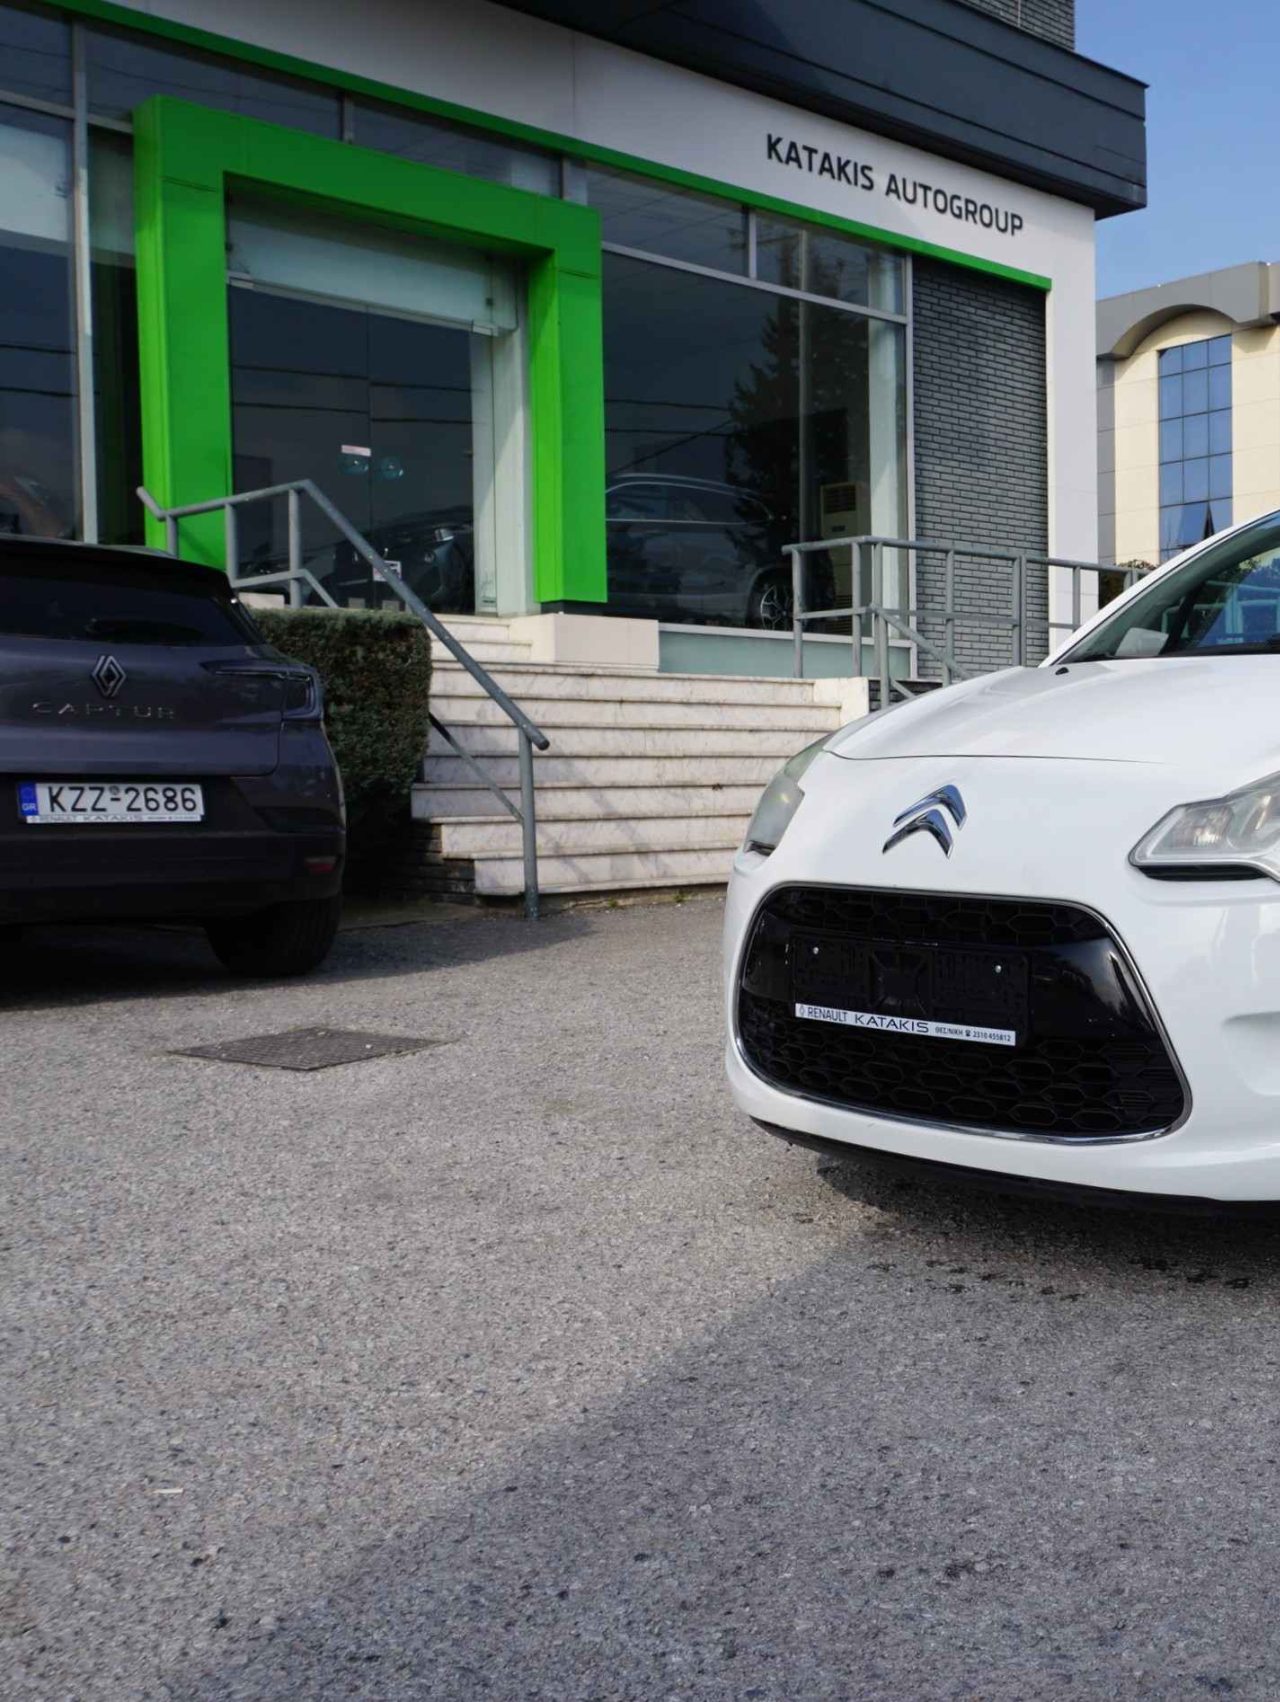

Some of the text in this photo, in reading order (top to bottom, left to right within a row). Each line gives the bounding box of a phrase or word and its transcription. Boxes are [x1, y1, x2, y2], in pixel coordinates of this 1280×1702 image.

[767, 134, 1023, 236] KATAKIS AUTOGROUP
[32, 701, 175, 719] CAPTUR
[22, 802, 37, 812] GR
[48, 785, 197, 812] KZZ-2686
[807, 1005, 848, 1022] RENAULT
[854, 1013, 930, 1034] KATAKIS
